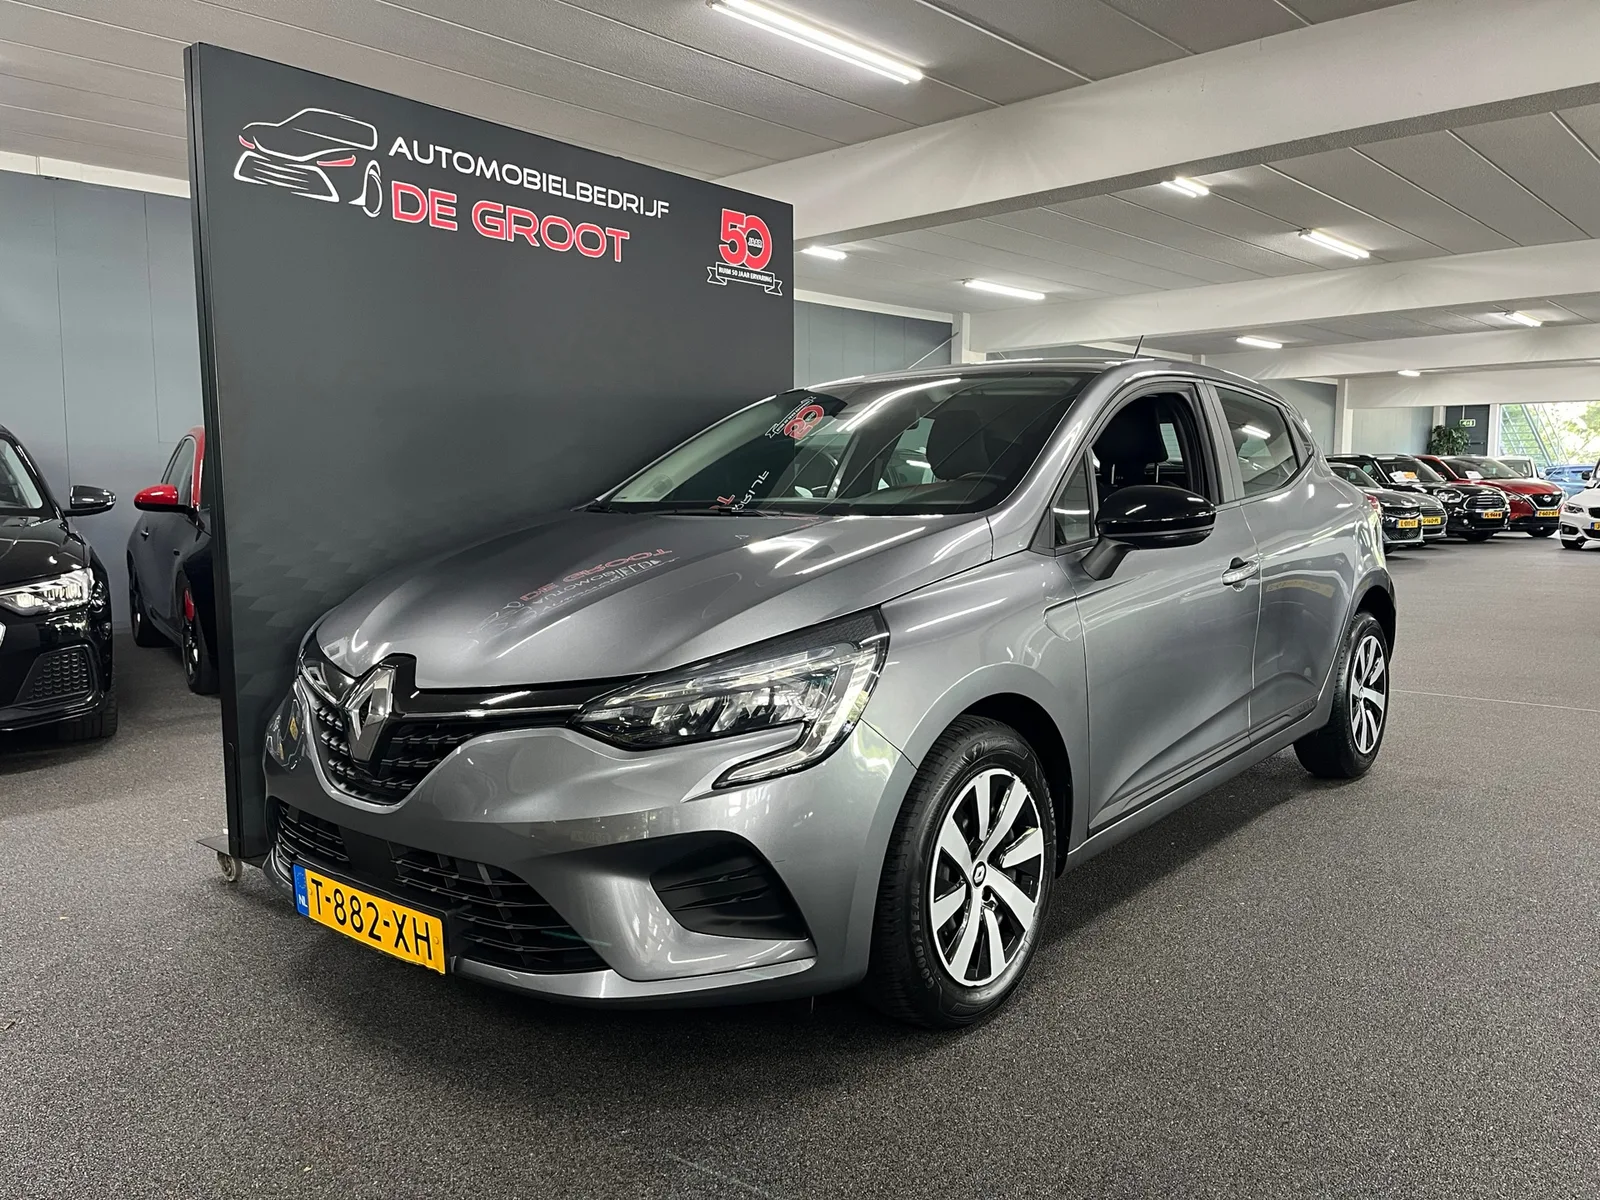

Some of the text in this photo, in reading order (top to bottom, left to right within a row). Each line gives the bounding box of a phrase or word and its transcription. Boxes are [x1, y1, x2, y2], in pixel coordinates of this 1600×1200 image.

[388, 136, 669, 218] AUTOMOBIELBEDRIJF
[391, 180, 630, 262] DE GROOT
[718, 208, 773, 271] 50
[311, 878, 432, 960] T-882-XH
